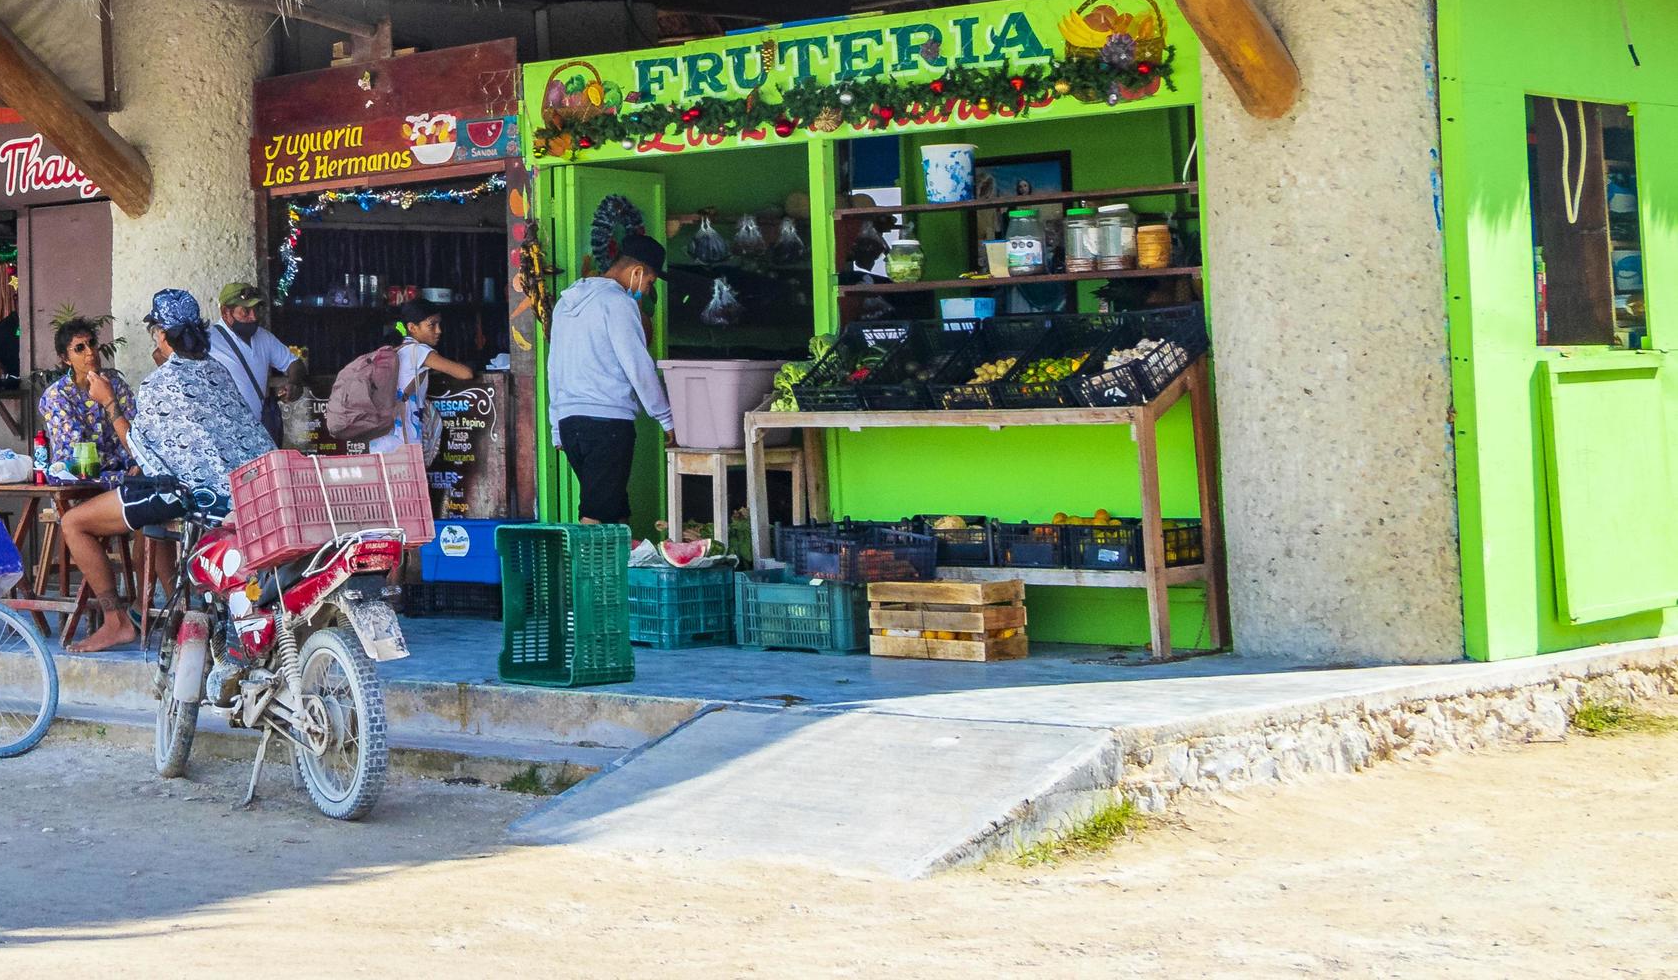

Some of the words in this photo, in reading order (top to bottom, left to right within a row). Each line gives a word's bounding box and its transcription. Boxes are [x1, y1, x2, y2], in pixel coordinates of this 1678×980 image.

[635, 11, 1053, 103] FRUTERIA
[263, 162, 295, 187] Los
[299, 161, 310, 182] 2
[314, 149, 412, 180] Hermanos
[434, 400, 470, 411] RESCAS
[462, 417, 486, 428] Pepino
[447, 441, 472, 452] Mango
[444, 452, 475, 462] Manzana
[429, 471, 459, 483] TELES
[446, 500, 469, 512] Mango
